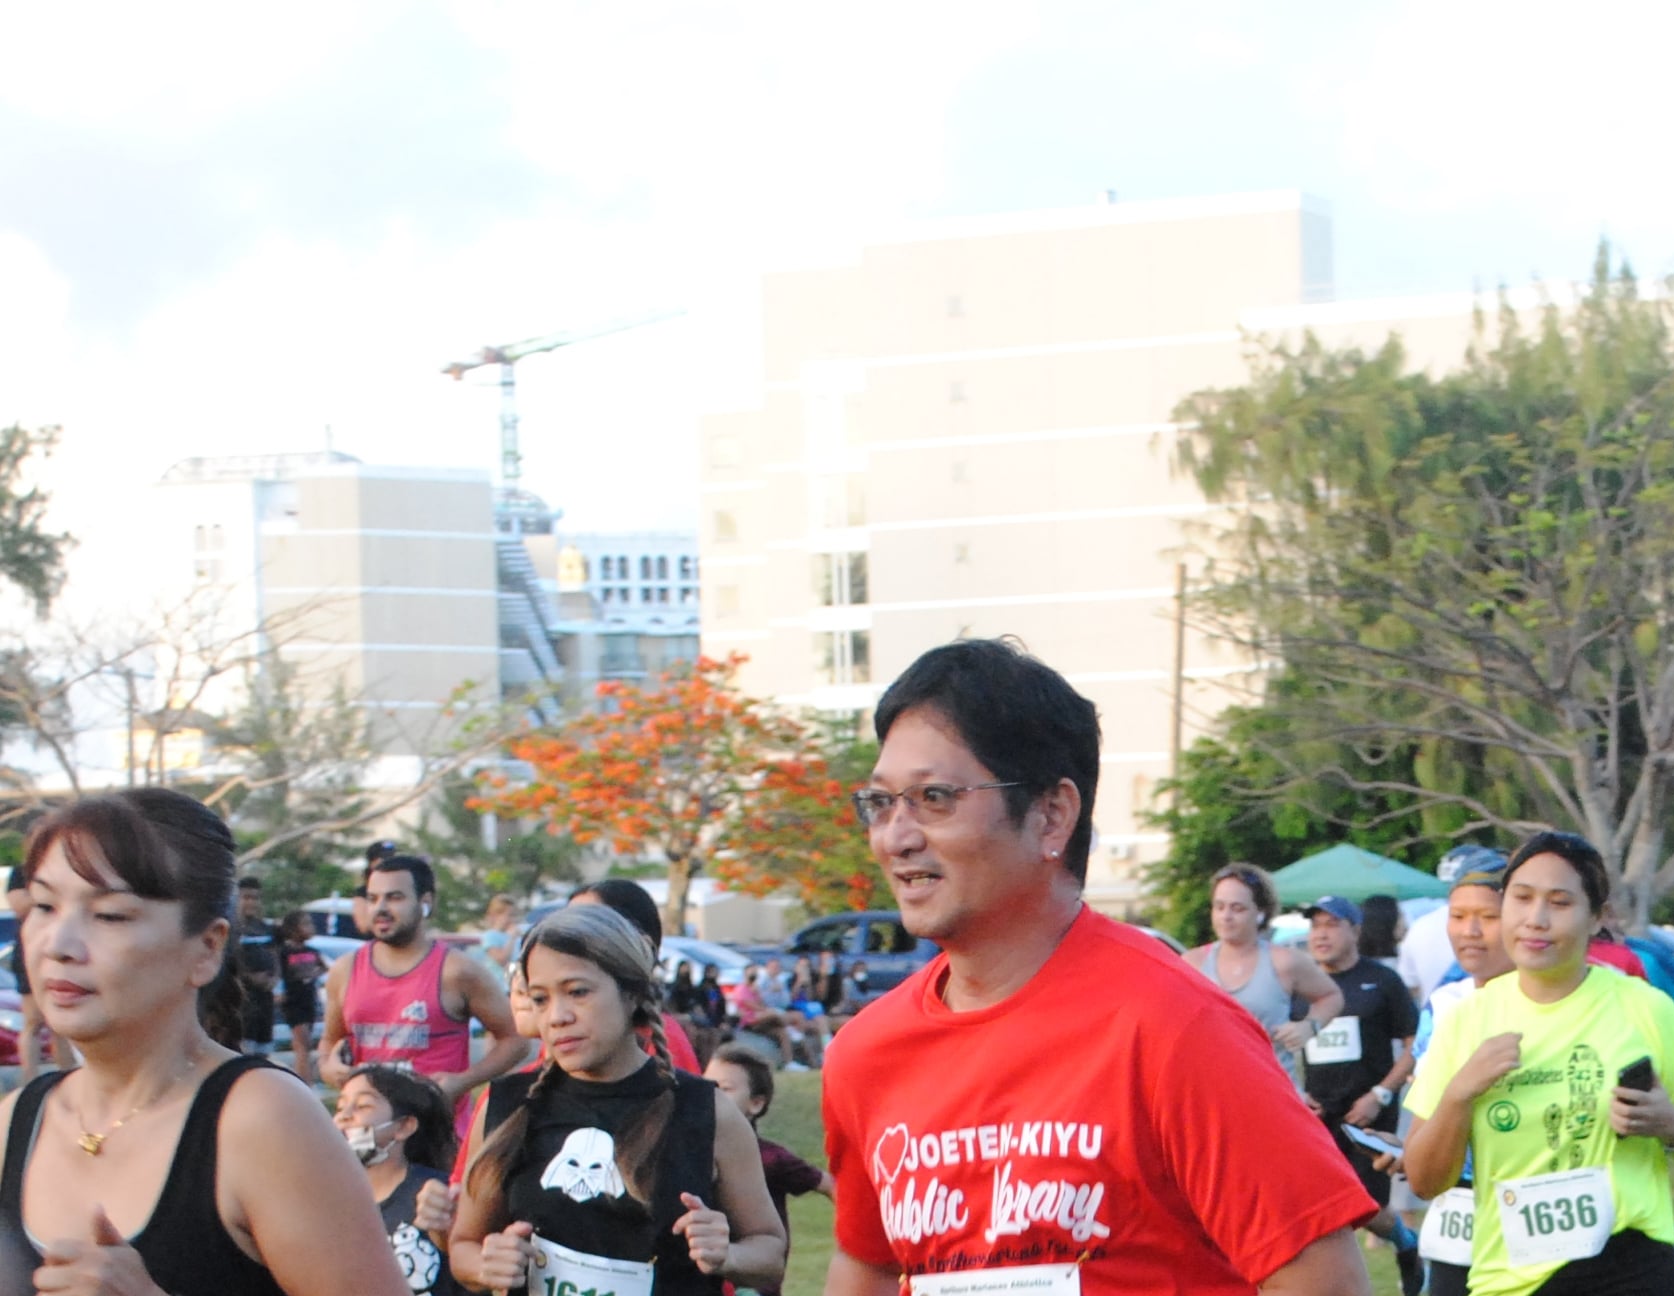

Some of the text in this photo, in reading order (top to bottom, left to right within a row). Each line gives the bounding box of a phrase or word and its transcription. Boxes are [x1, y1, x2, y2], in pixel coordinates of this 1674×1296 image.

[904, 1122, 1103, 1172] JOETEN-KIYU
[985, 1160, 1111, 1243] Lbrary
[1519, 1193, 1598, 1237] 1636
[1440, 1211, 1474, 1241] 168
